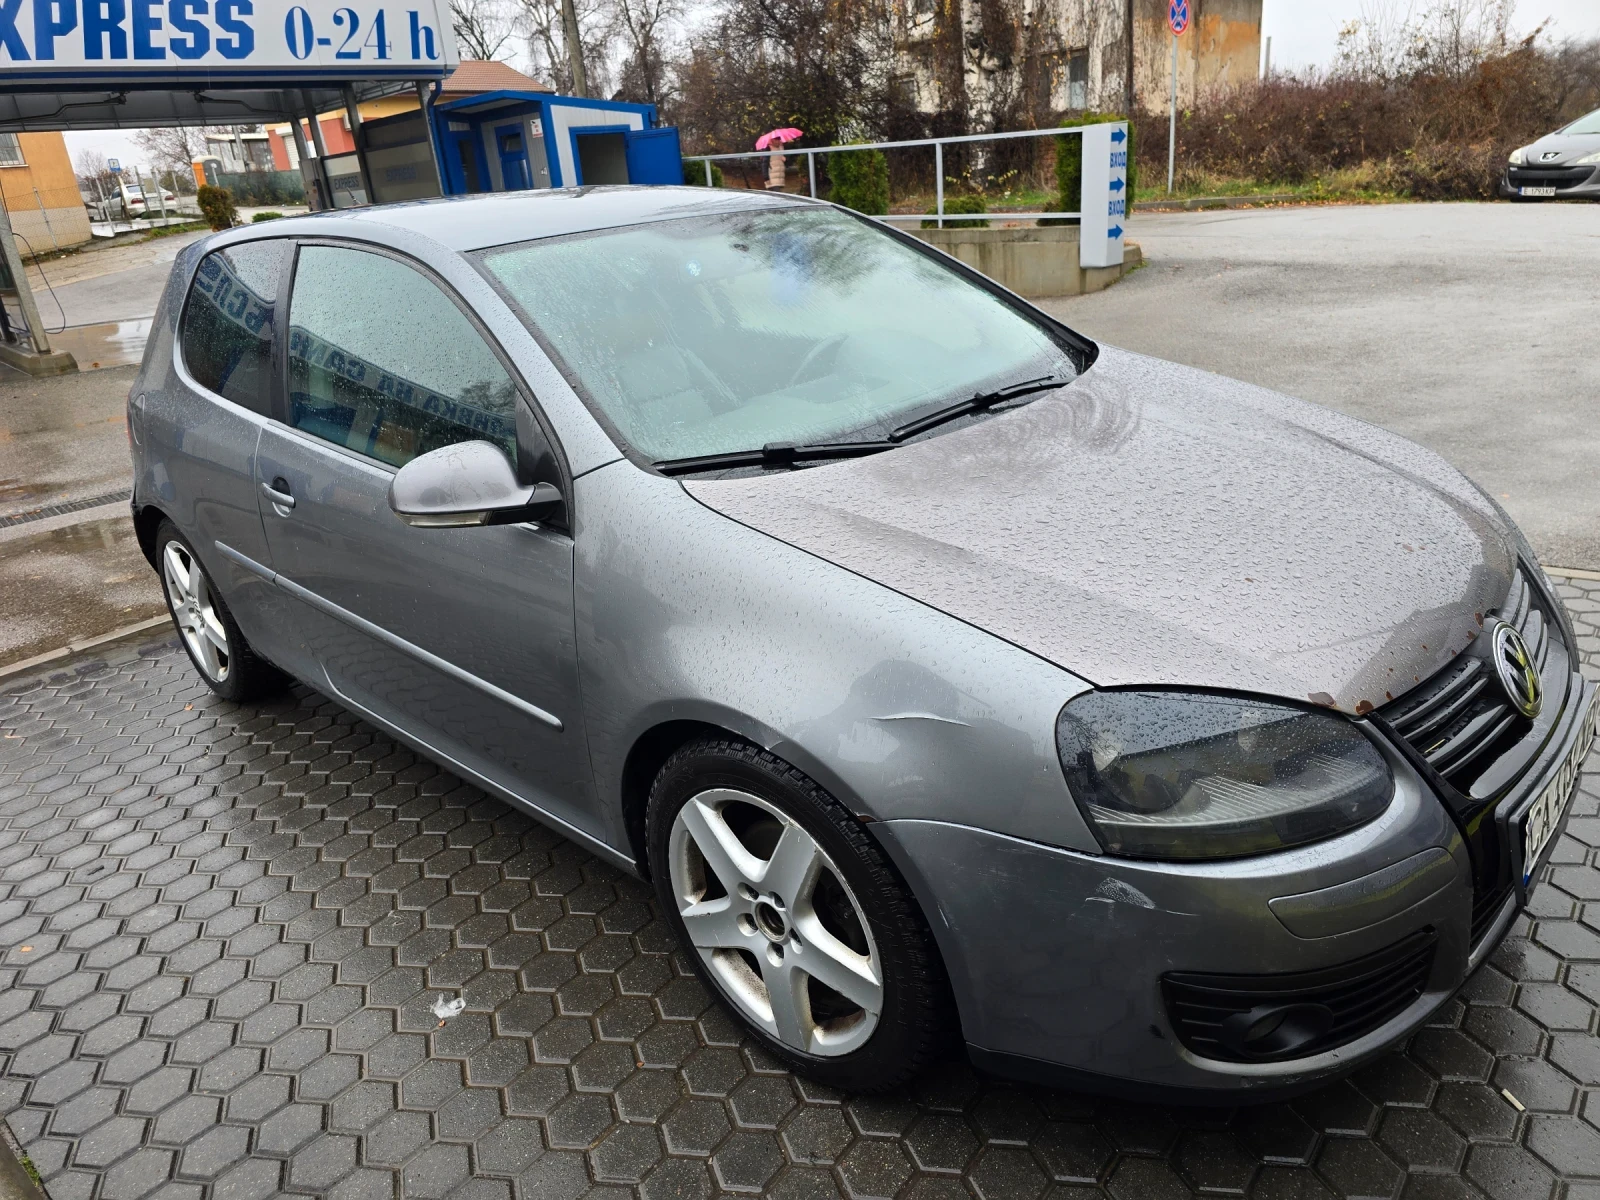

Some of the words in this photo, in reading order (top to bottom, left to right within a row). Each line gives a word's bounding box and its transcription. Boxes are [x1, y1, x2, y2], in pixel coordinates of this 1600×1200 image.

[284, 5, 393, 61] 0-24
[406, 10, 441, 61] h
[1110, 151, 1126, 169] ВХОД
[1108, 200, 1125, 217] ВХОД
